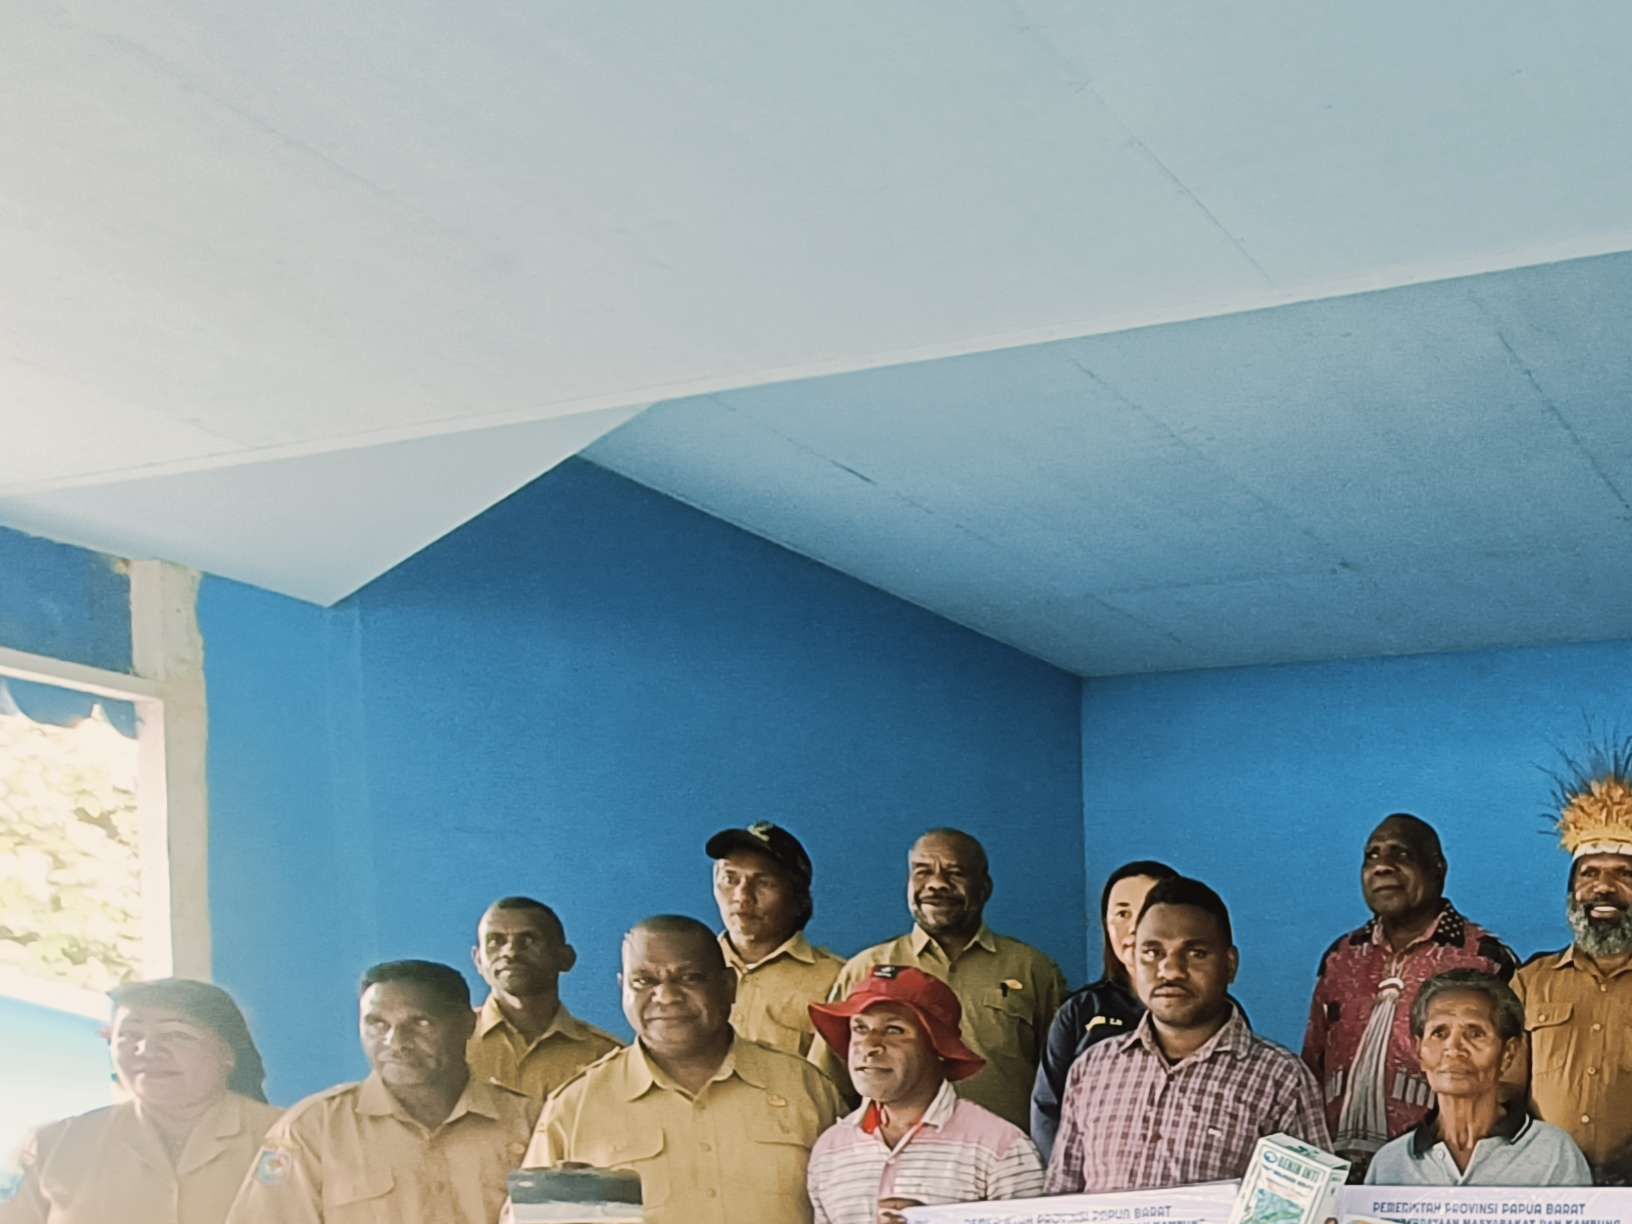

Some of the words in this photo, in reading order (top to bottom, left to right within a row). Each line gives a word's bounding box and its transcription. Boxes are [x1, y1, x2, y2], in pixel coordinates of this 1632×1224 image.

[1445, 1202, 1499, 1214] PROVINSI
[1502, 1203, 1542, 1214] PAPUA
[1546, 1203, 1586, 1215] BARAT
